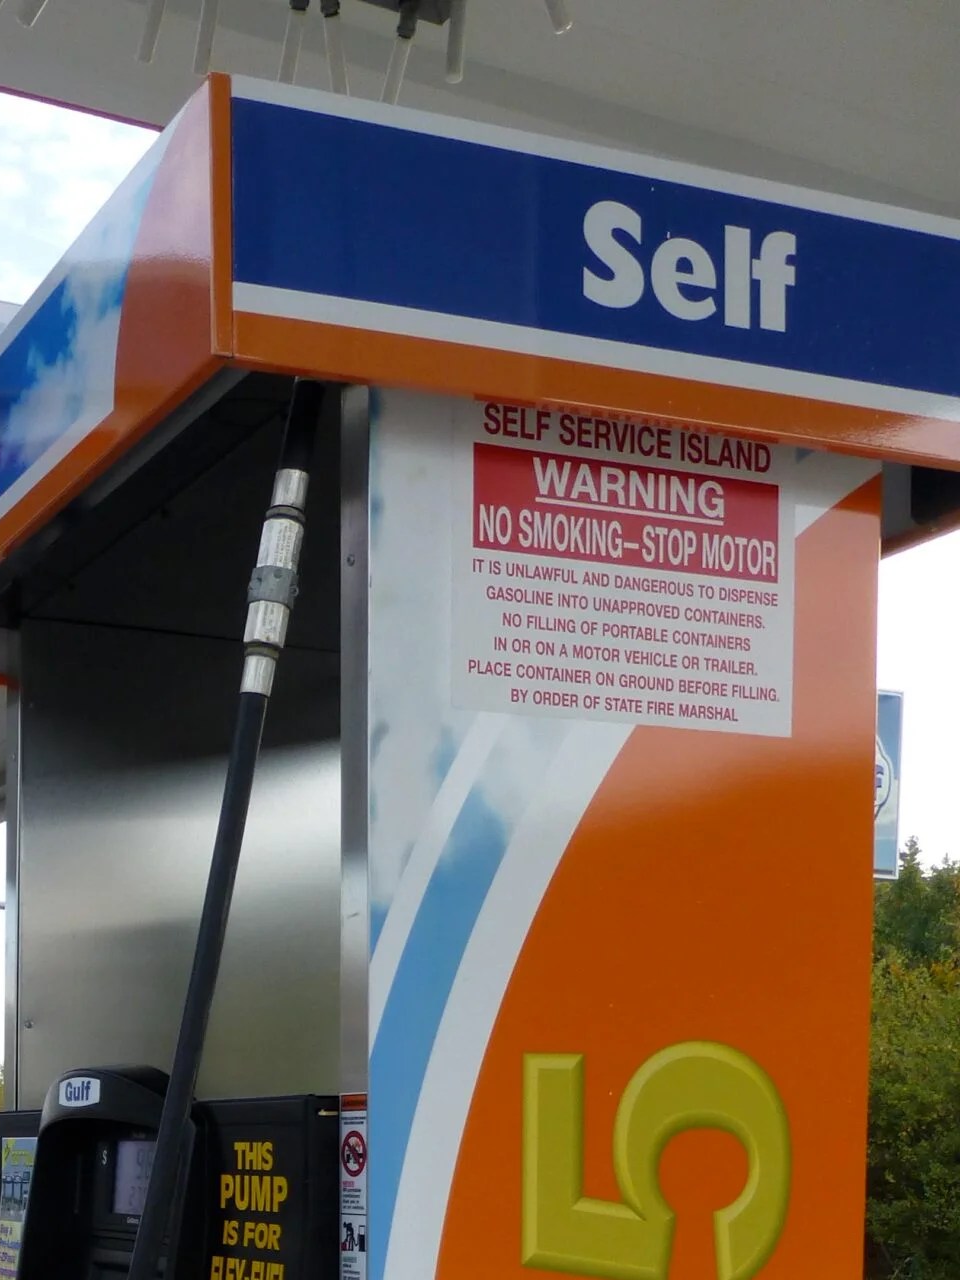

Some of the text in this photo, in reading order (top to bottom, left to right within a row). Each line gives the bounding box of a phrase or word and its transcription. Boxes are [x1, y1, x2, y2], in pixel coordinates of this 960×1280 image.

[583, 200, 797, 333] Self
[483, 402, 772, 473] SELF SERVICE ISLAND
[532, 456, 725, 519] WARNING
[478, 503, 512, 545] NO
[702, 532, 776, 577] MOTOR
[473, 559, 779, 607] IT IS UNLAWFUL AND DANGEROUS TO DISPENSE
[486, 585, 766, 629] GASOLINE INTO UNAPPROVED CONTAINERS.
[502, 612, 751, 651] NO FILLING OF PORTABLE CONTAINERS
[494, 637, 758, 676] IN OR ON A MOTOR VEHICLE OR TRAILER.
[468, 659, 780, 702] PLACE CONTAINER ON GROUND BEFORE FILLING.
[511, 688, 739, 721] BY ORDER OF STATE FIRE MARSHAL
[65, 1080, 91, 1102] Gulf
[233, 1141, 273, 1171] THIS
[220, 1174, 288, 1213] PUMP
[222, 1220, 281, 1250] IS FOR
